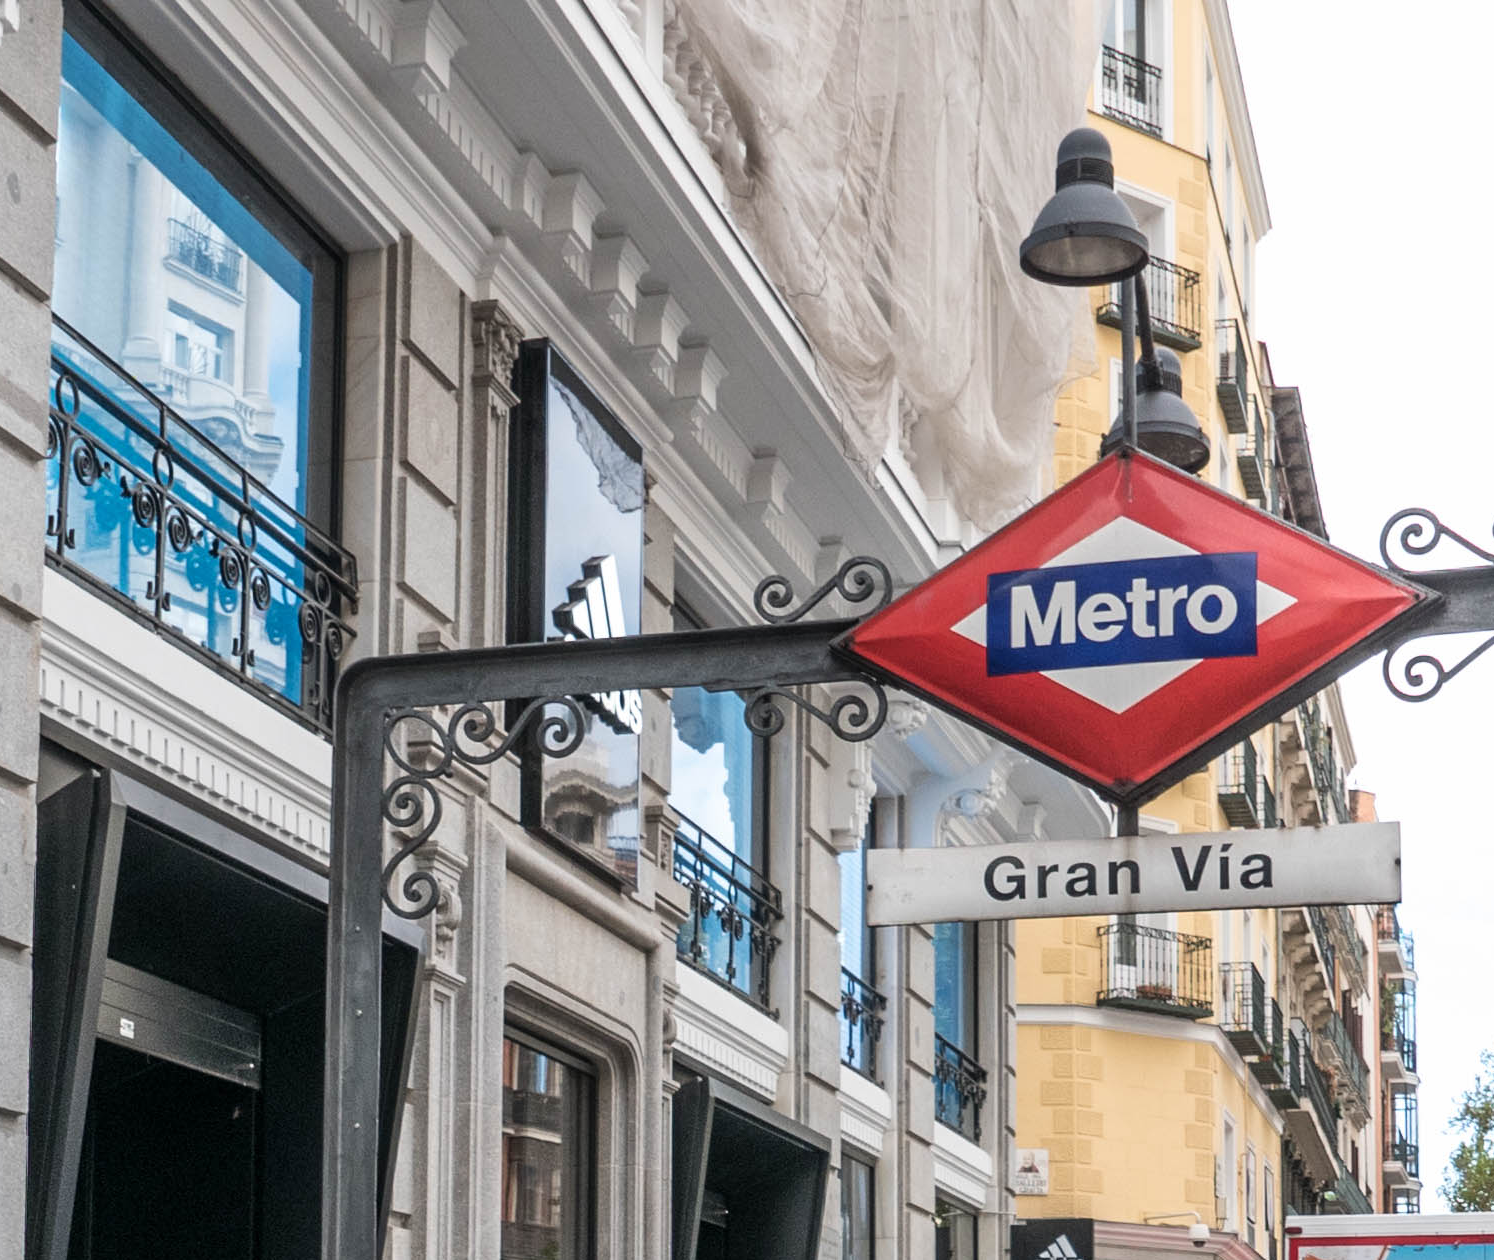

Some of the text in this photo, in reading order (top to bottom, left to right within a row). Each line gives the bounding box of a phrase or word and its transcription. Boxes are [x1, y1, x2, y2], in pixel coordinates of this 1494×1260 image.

[1010, 578, 1238, 649] Metro
[983, 843, 1274, 901] Gran Vía
